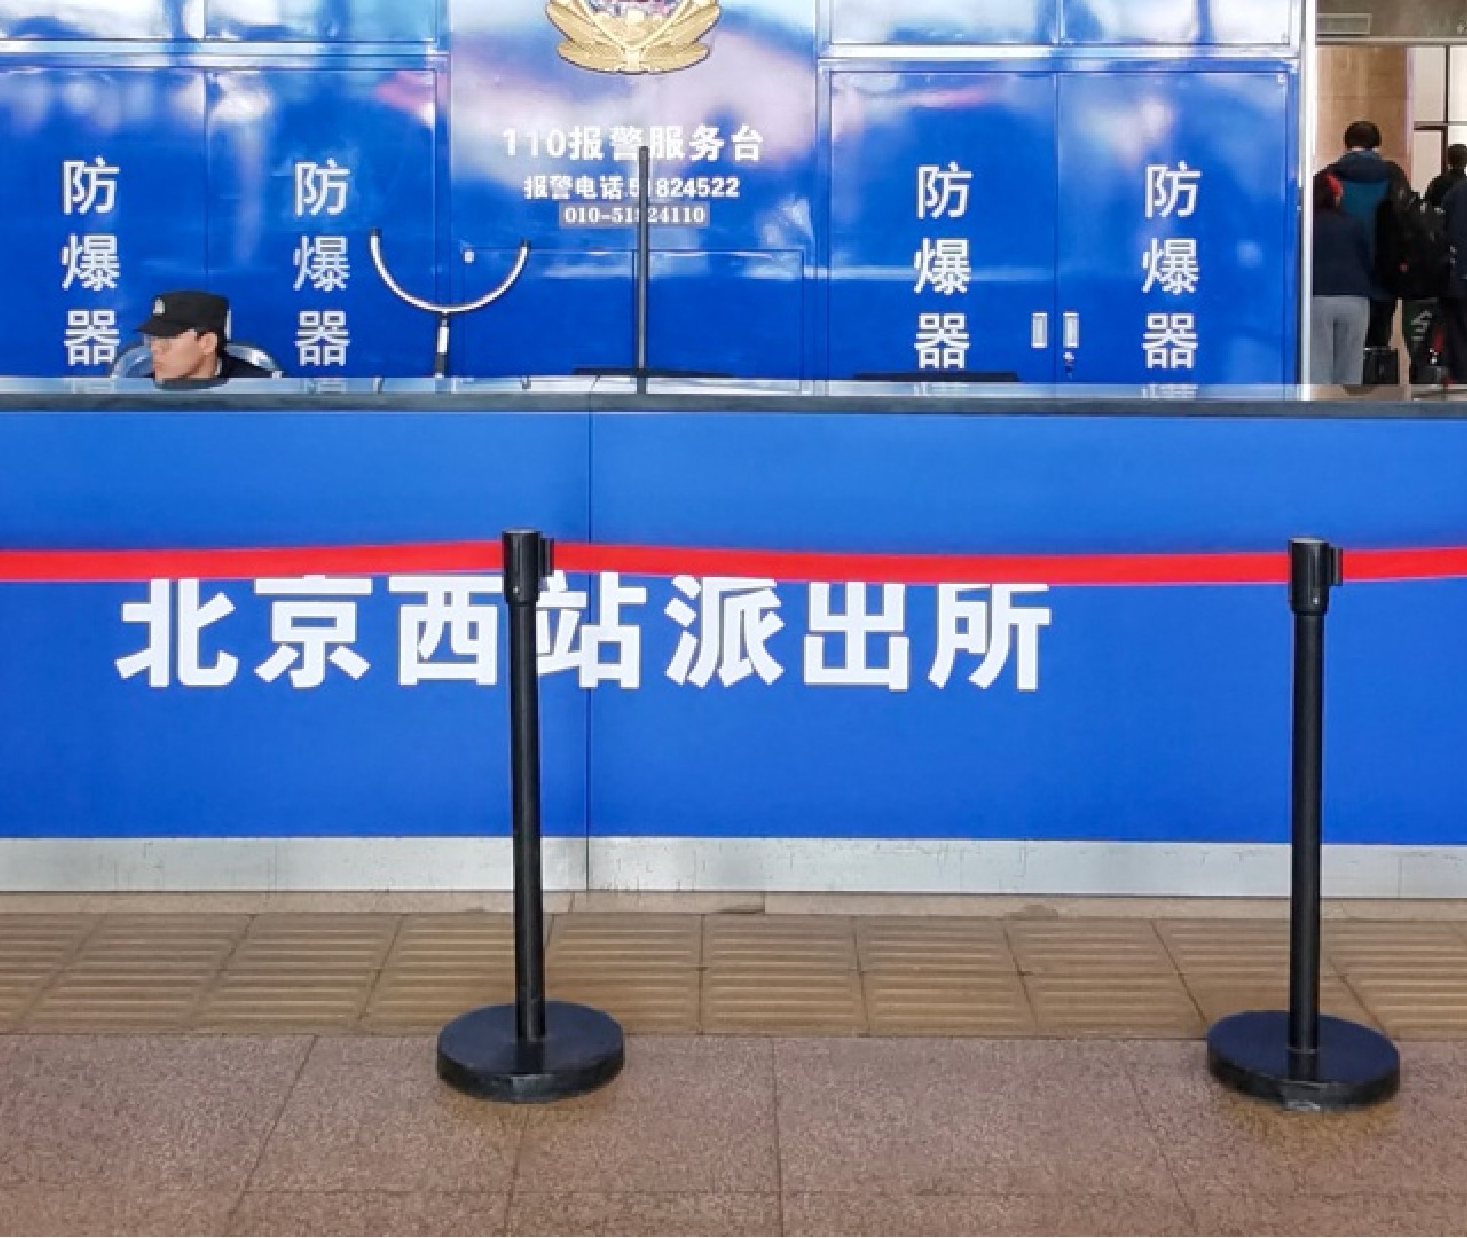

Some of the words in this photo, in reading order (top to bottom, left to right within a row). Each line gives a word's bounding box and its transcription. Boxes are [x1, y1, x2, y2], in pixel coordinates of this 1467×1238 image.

[503, 123, 763, 161] 110报警服务台
[564, 207, 706, 223] 010-5124110
[60, 156, 120, 367] 防爆器
[292, 158, 351, 367] 防爆器
[913, 161, 973, 370] 防爆器
[1141, 161, 1202, 370] 防爆器
[114, 570, 1052, 692] 北京西站派出所
